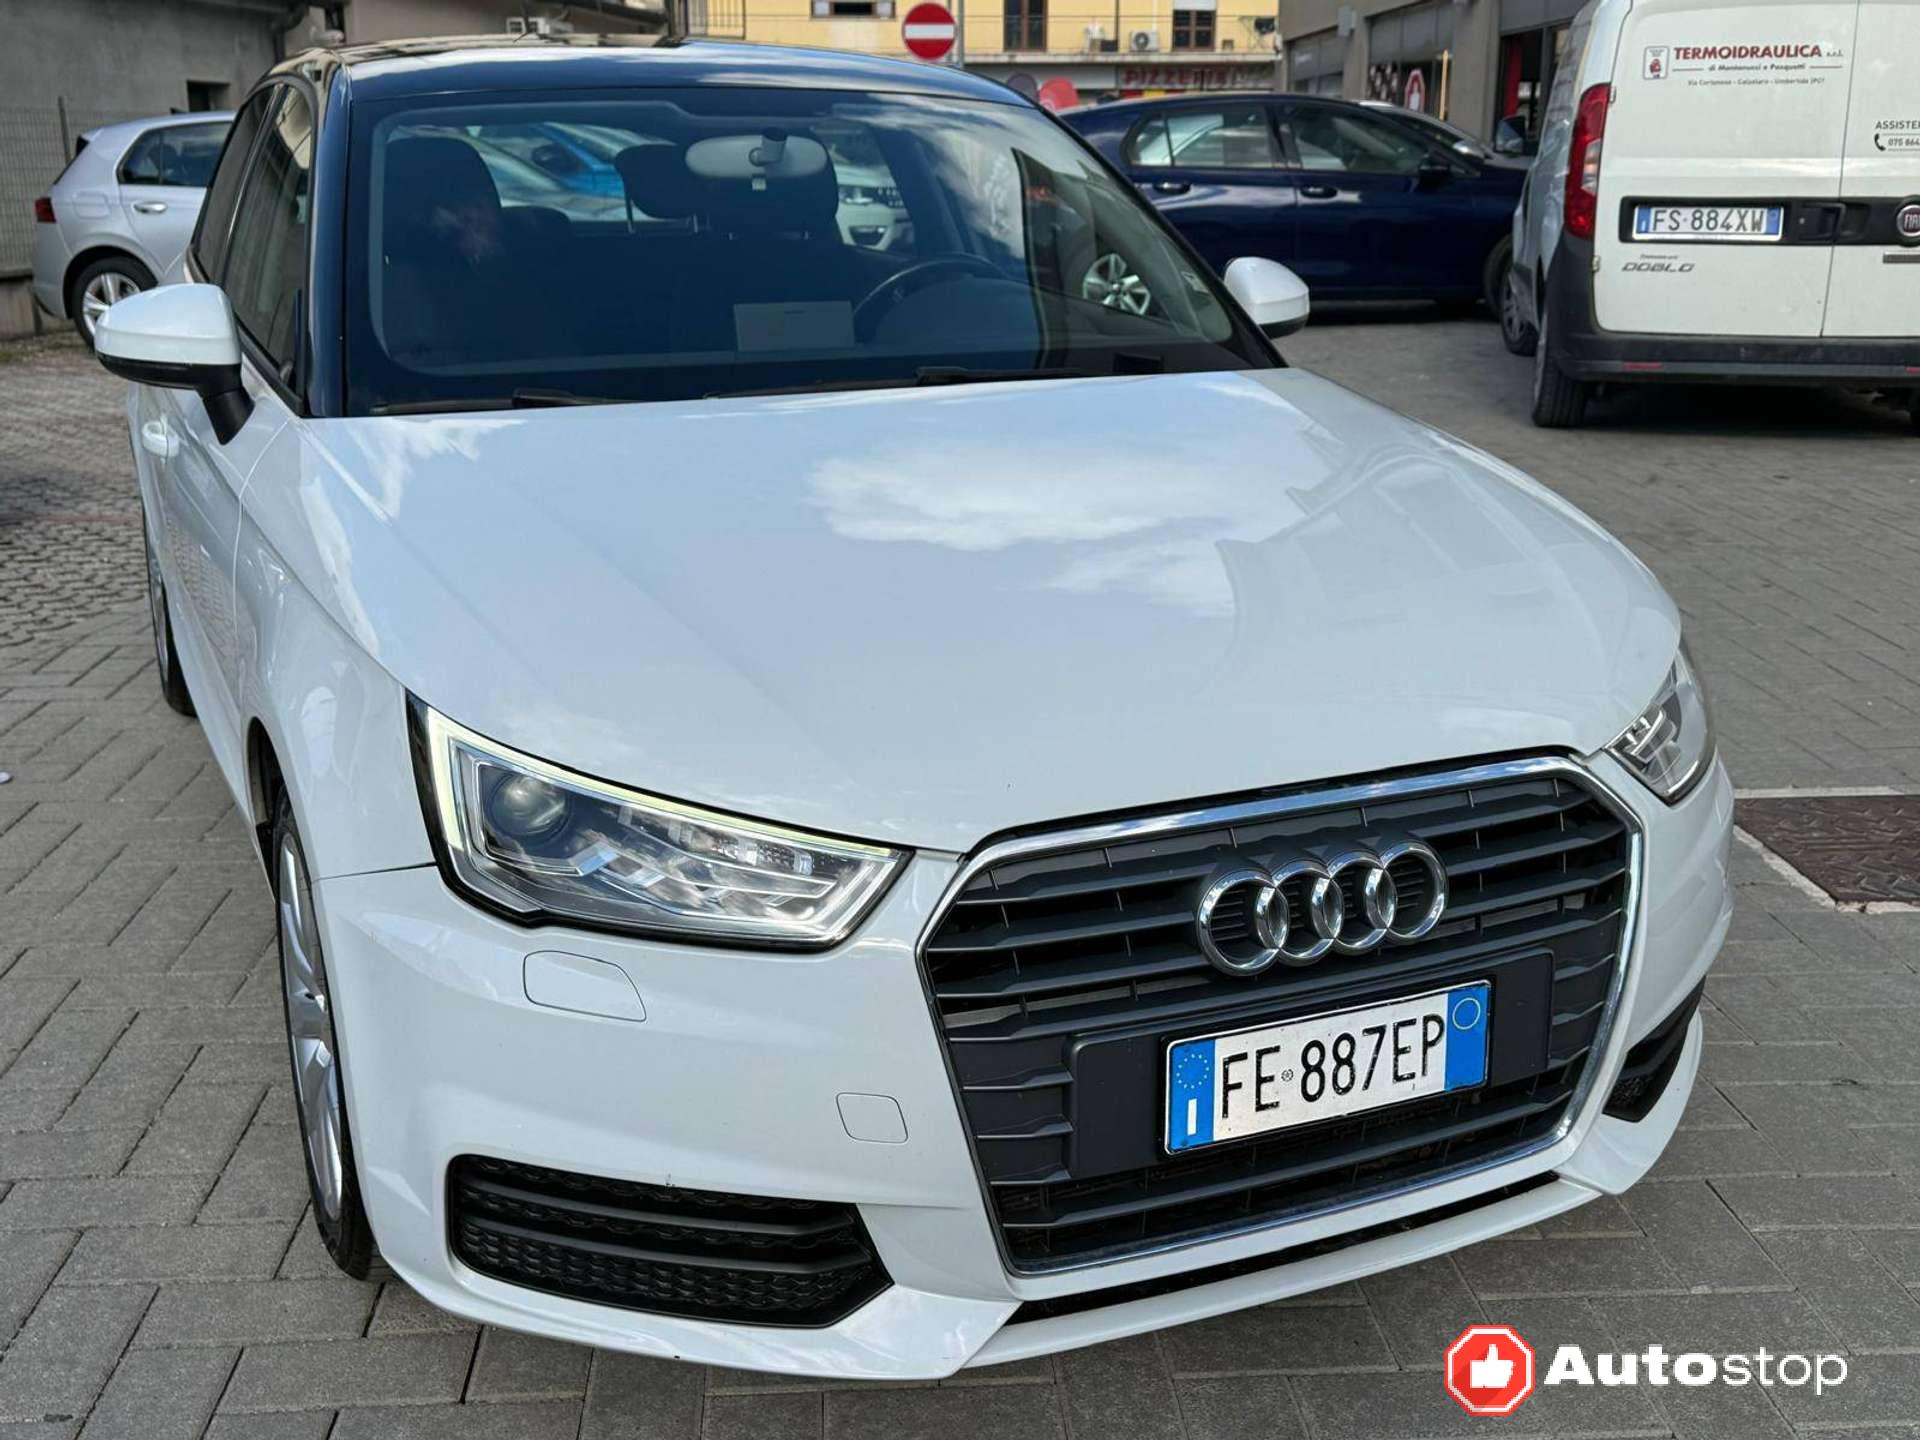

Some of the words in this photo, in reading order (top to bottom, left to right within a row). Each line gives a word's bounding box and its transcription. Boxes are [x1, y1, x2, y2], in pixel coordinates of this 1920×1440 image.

[1673, 44, 1822, 60] TERMOIDRAULICA
[1652, 209, 1682, 232] FS
[1690, 209, 1764, 233] 884XW
[1221, 1044, 1282, 1120] FE
[1300, 1013, 1445, 1103] 887EP
